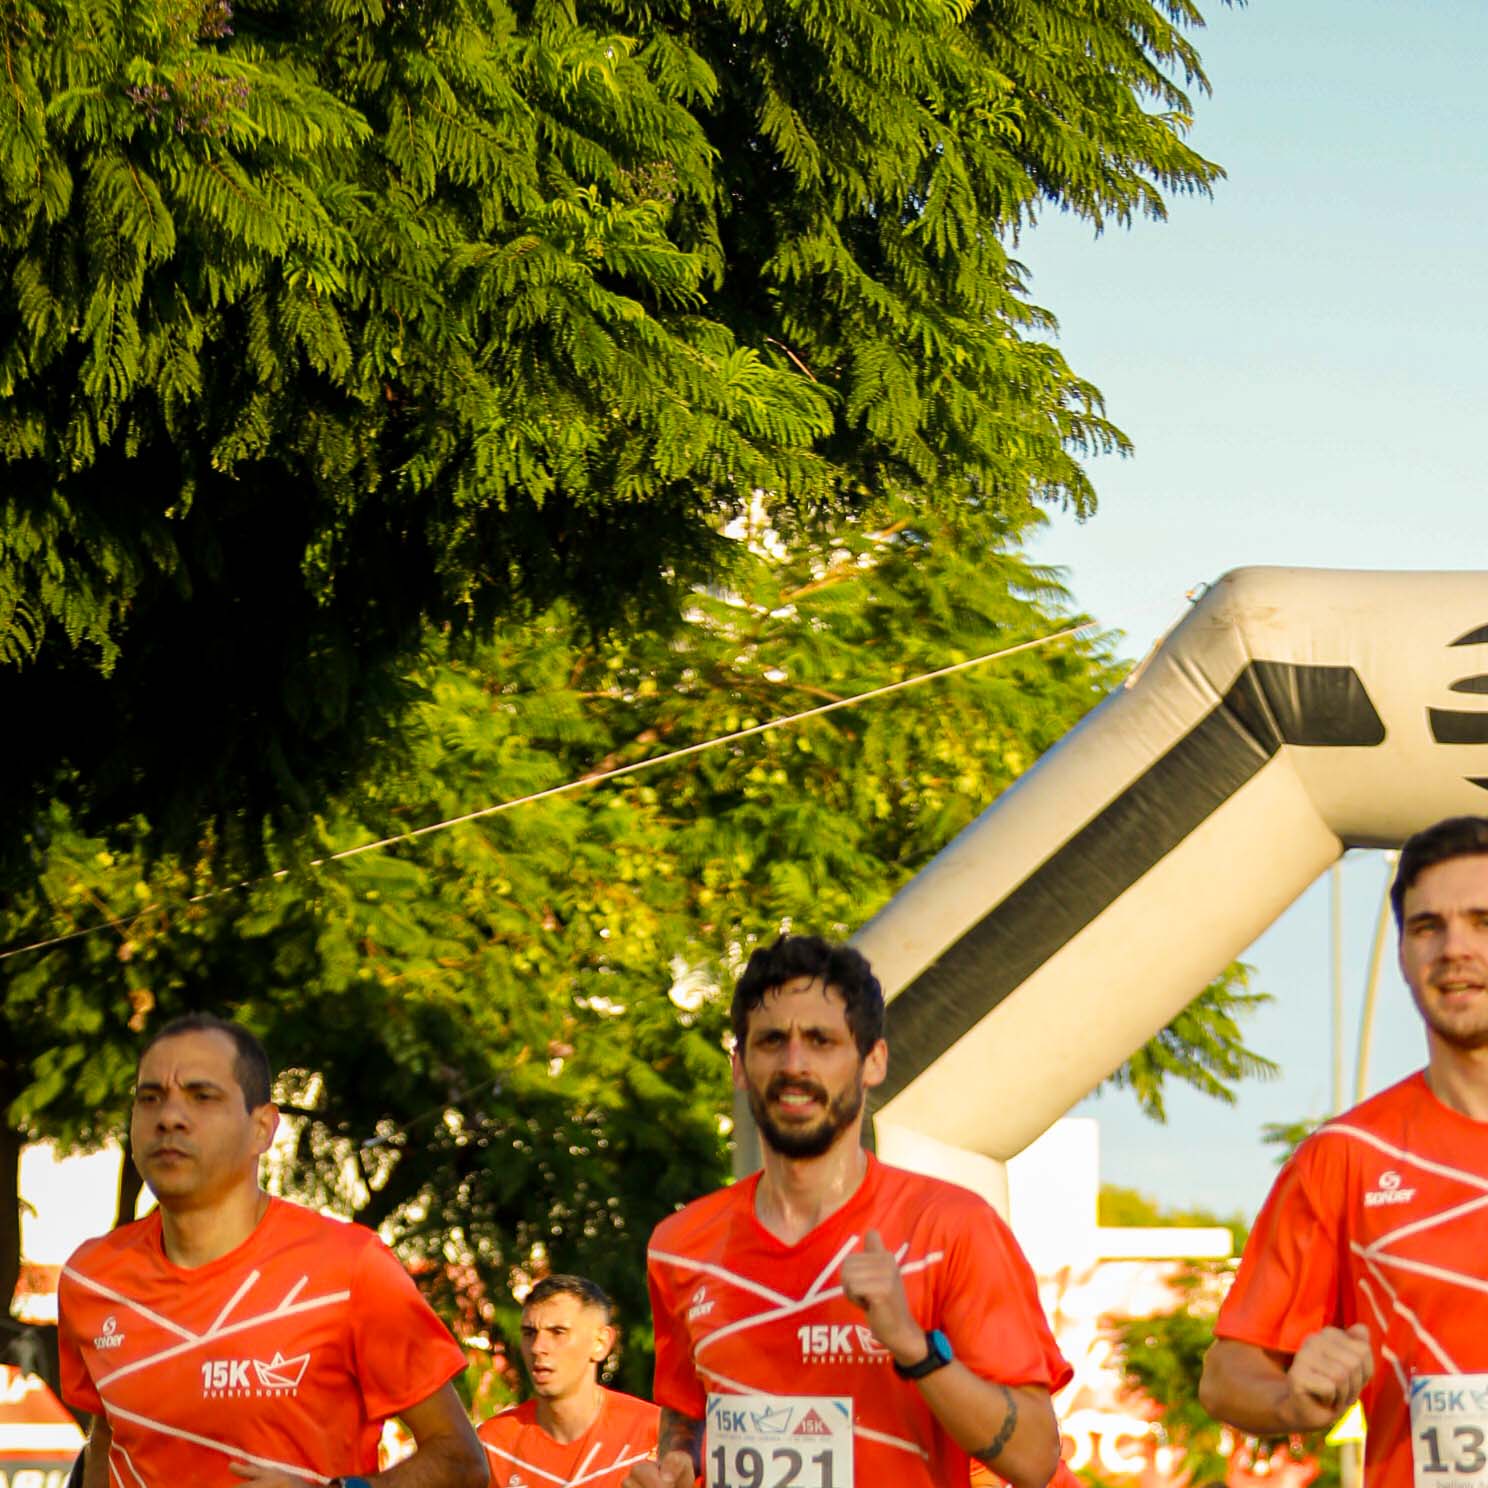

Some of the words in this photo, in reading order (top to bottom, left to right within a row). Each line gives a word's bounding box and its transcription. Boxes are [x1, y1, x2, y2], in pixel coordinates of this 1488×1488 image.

[797, 1324, 853, 1354] 15K
[858, 1354, 892, 1364] NORT
[201, 1359, 250, 1389] 15K
[203, 1389, 251, 1399] PUERTO
[1423, 1390, 1465, 1412] 15K
[715, 1410, 747, 1433] 15K
